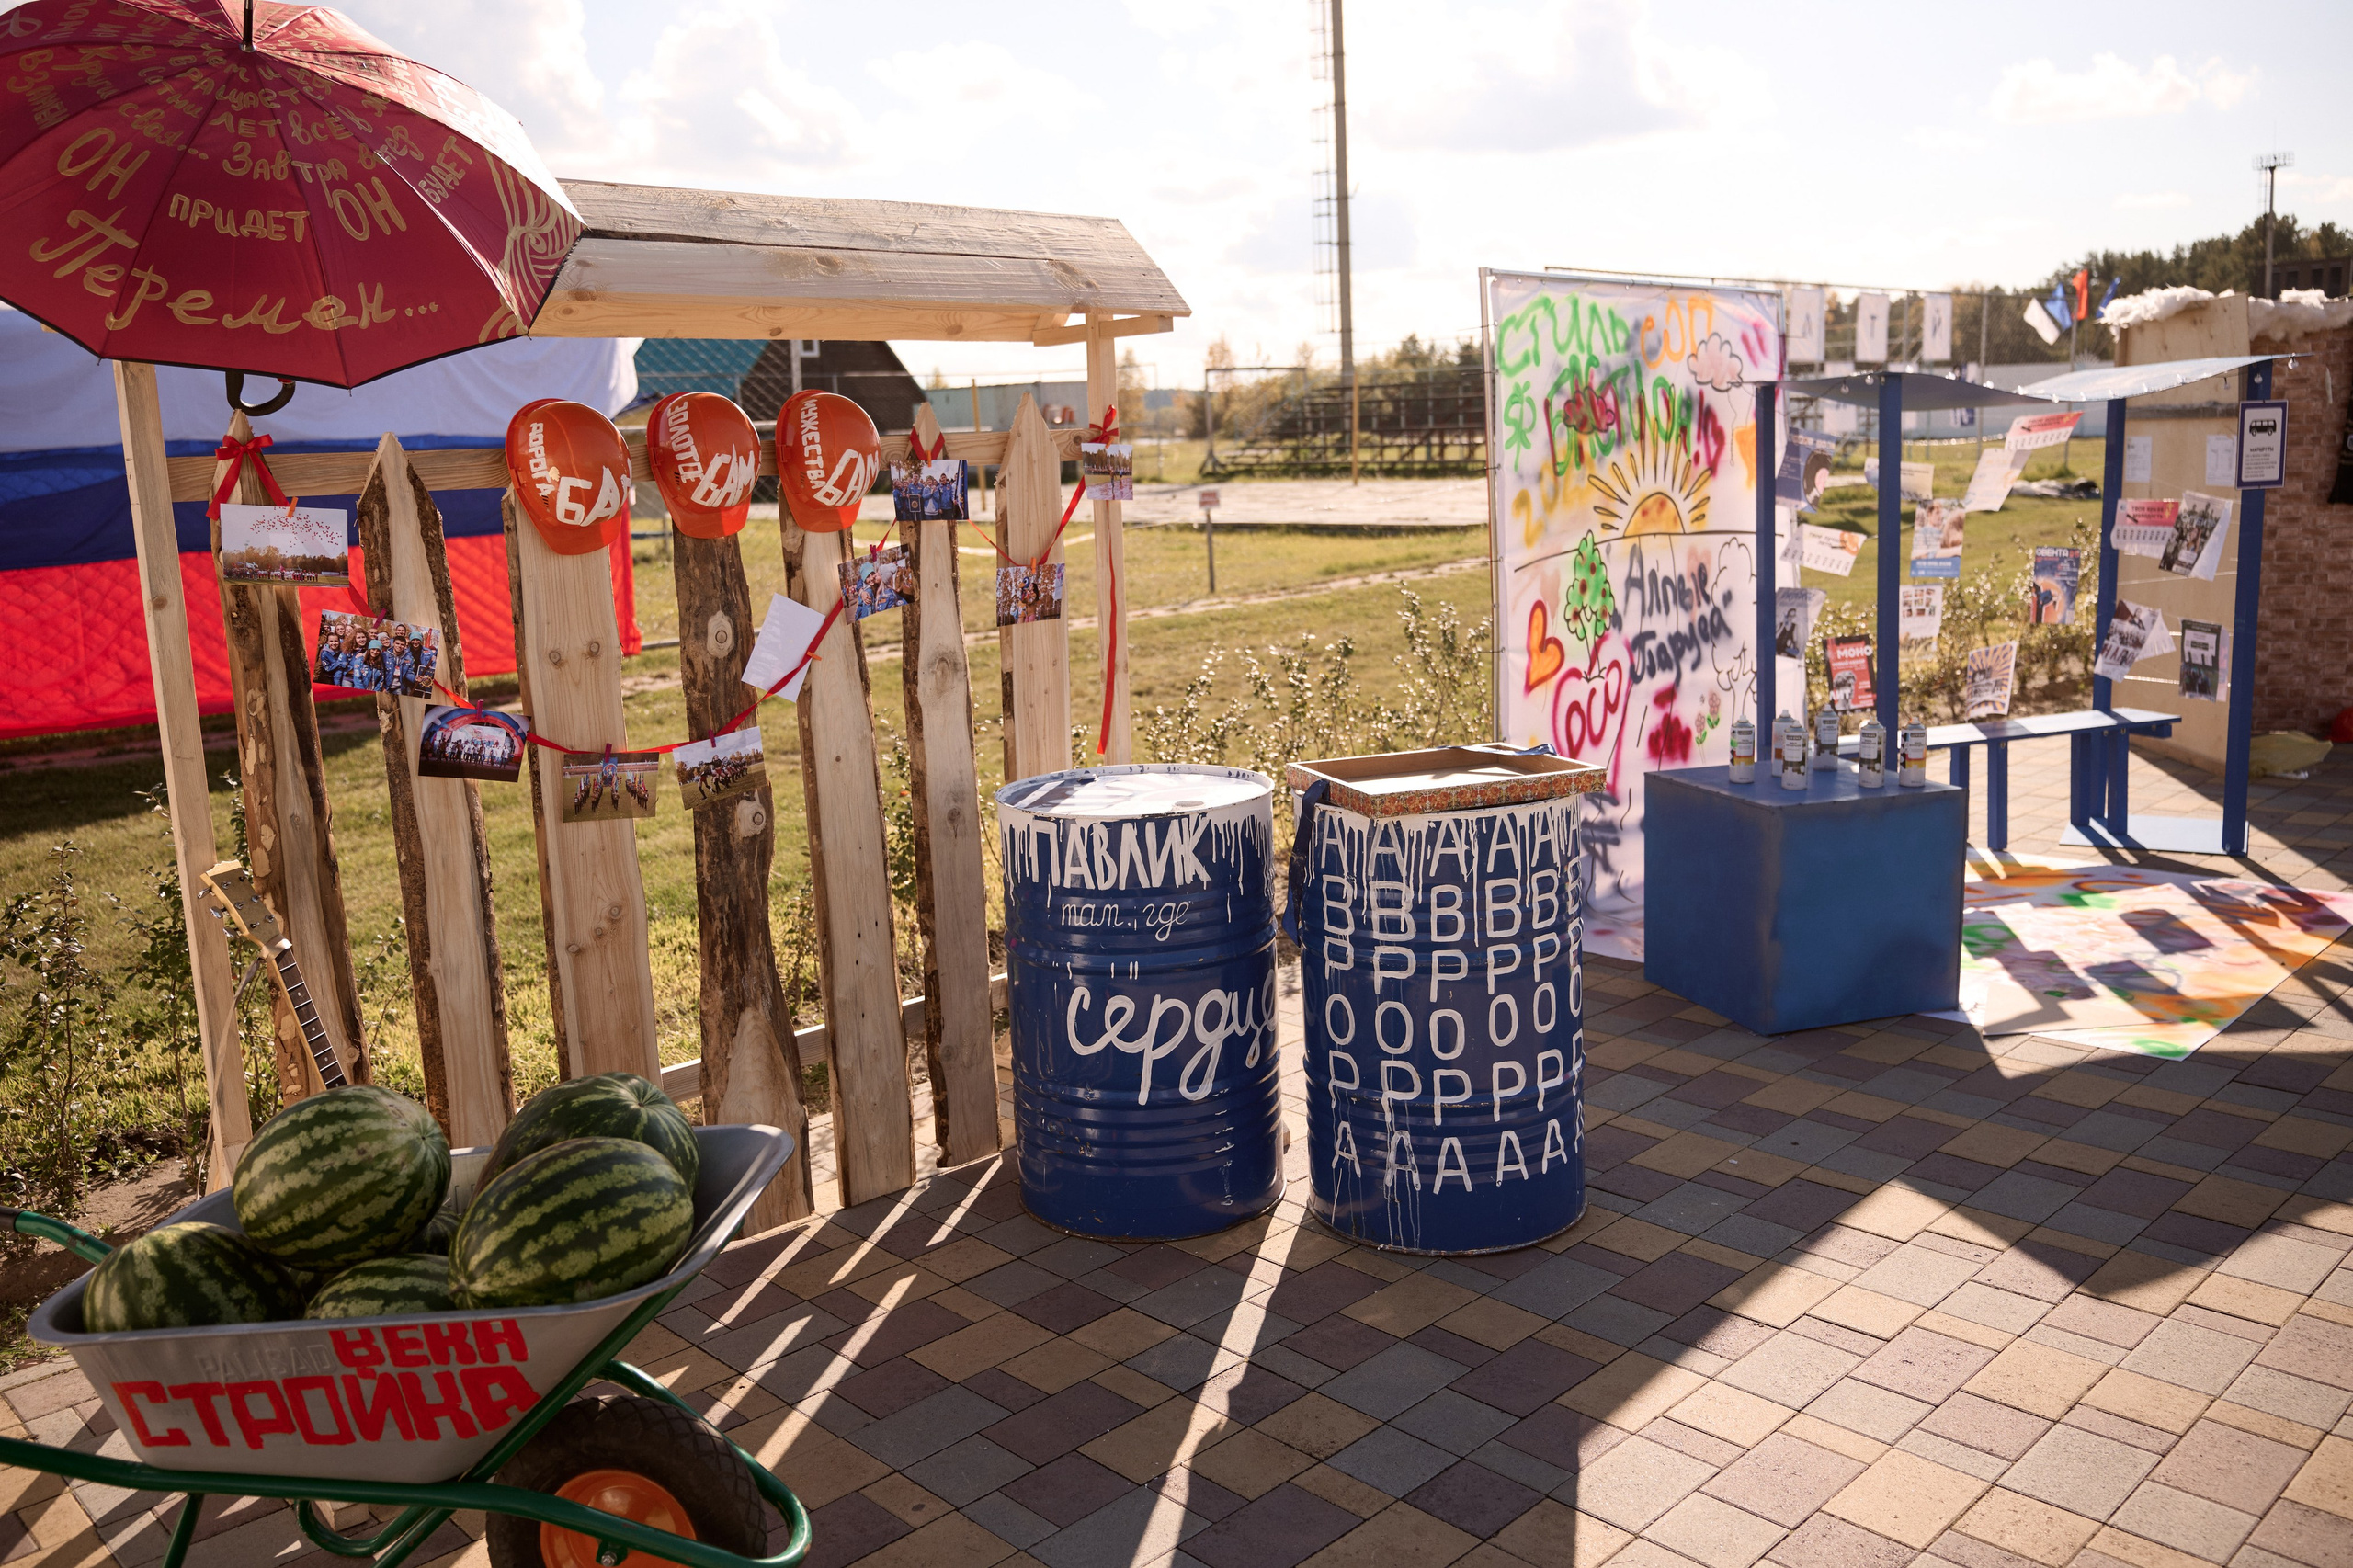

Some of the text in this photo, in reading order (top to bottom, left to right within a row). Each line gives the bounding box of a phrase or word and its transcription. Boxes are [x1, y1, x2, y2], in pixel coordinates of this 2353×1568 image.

[57, 127, 473, 243] ОН ПРИДЕТ ОН БУДЕТ
[527, 422, 557, 498] ДОРОГА
[800, 398, 827, 491] МУЖЕСТВА
[1836, 645, 1873, 659] МОНО
[1030, 816, 1212, 892] ПАВЛИК
[1142, 902, 1189, 943] где
[1065, 969, 1279, 1106] сердце
[328, 1318, 530, 1369] ВЕКА
[110, 1364, 542, 1450] СТРОЙКА
